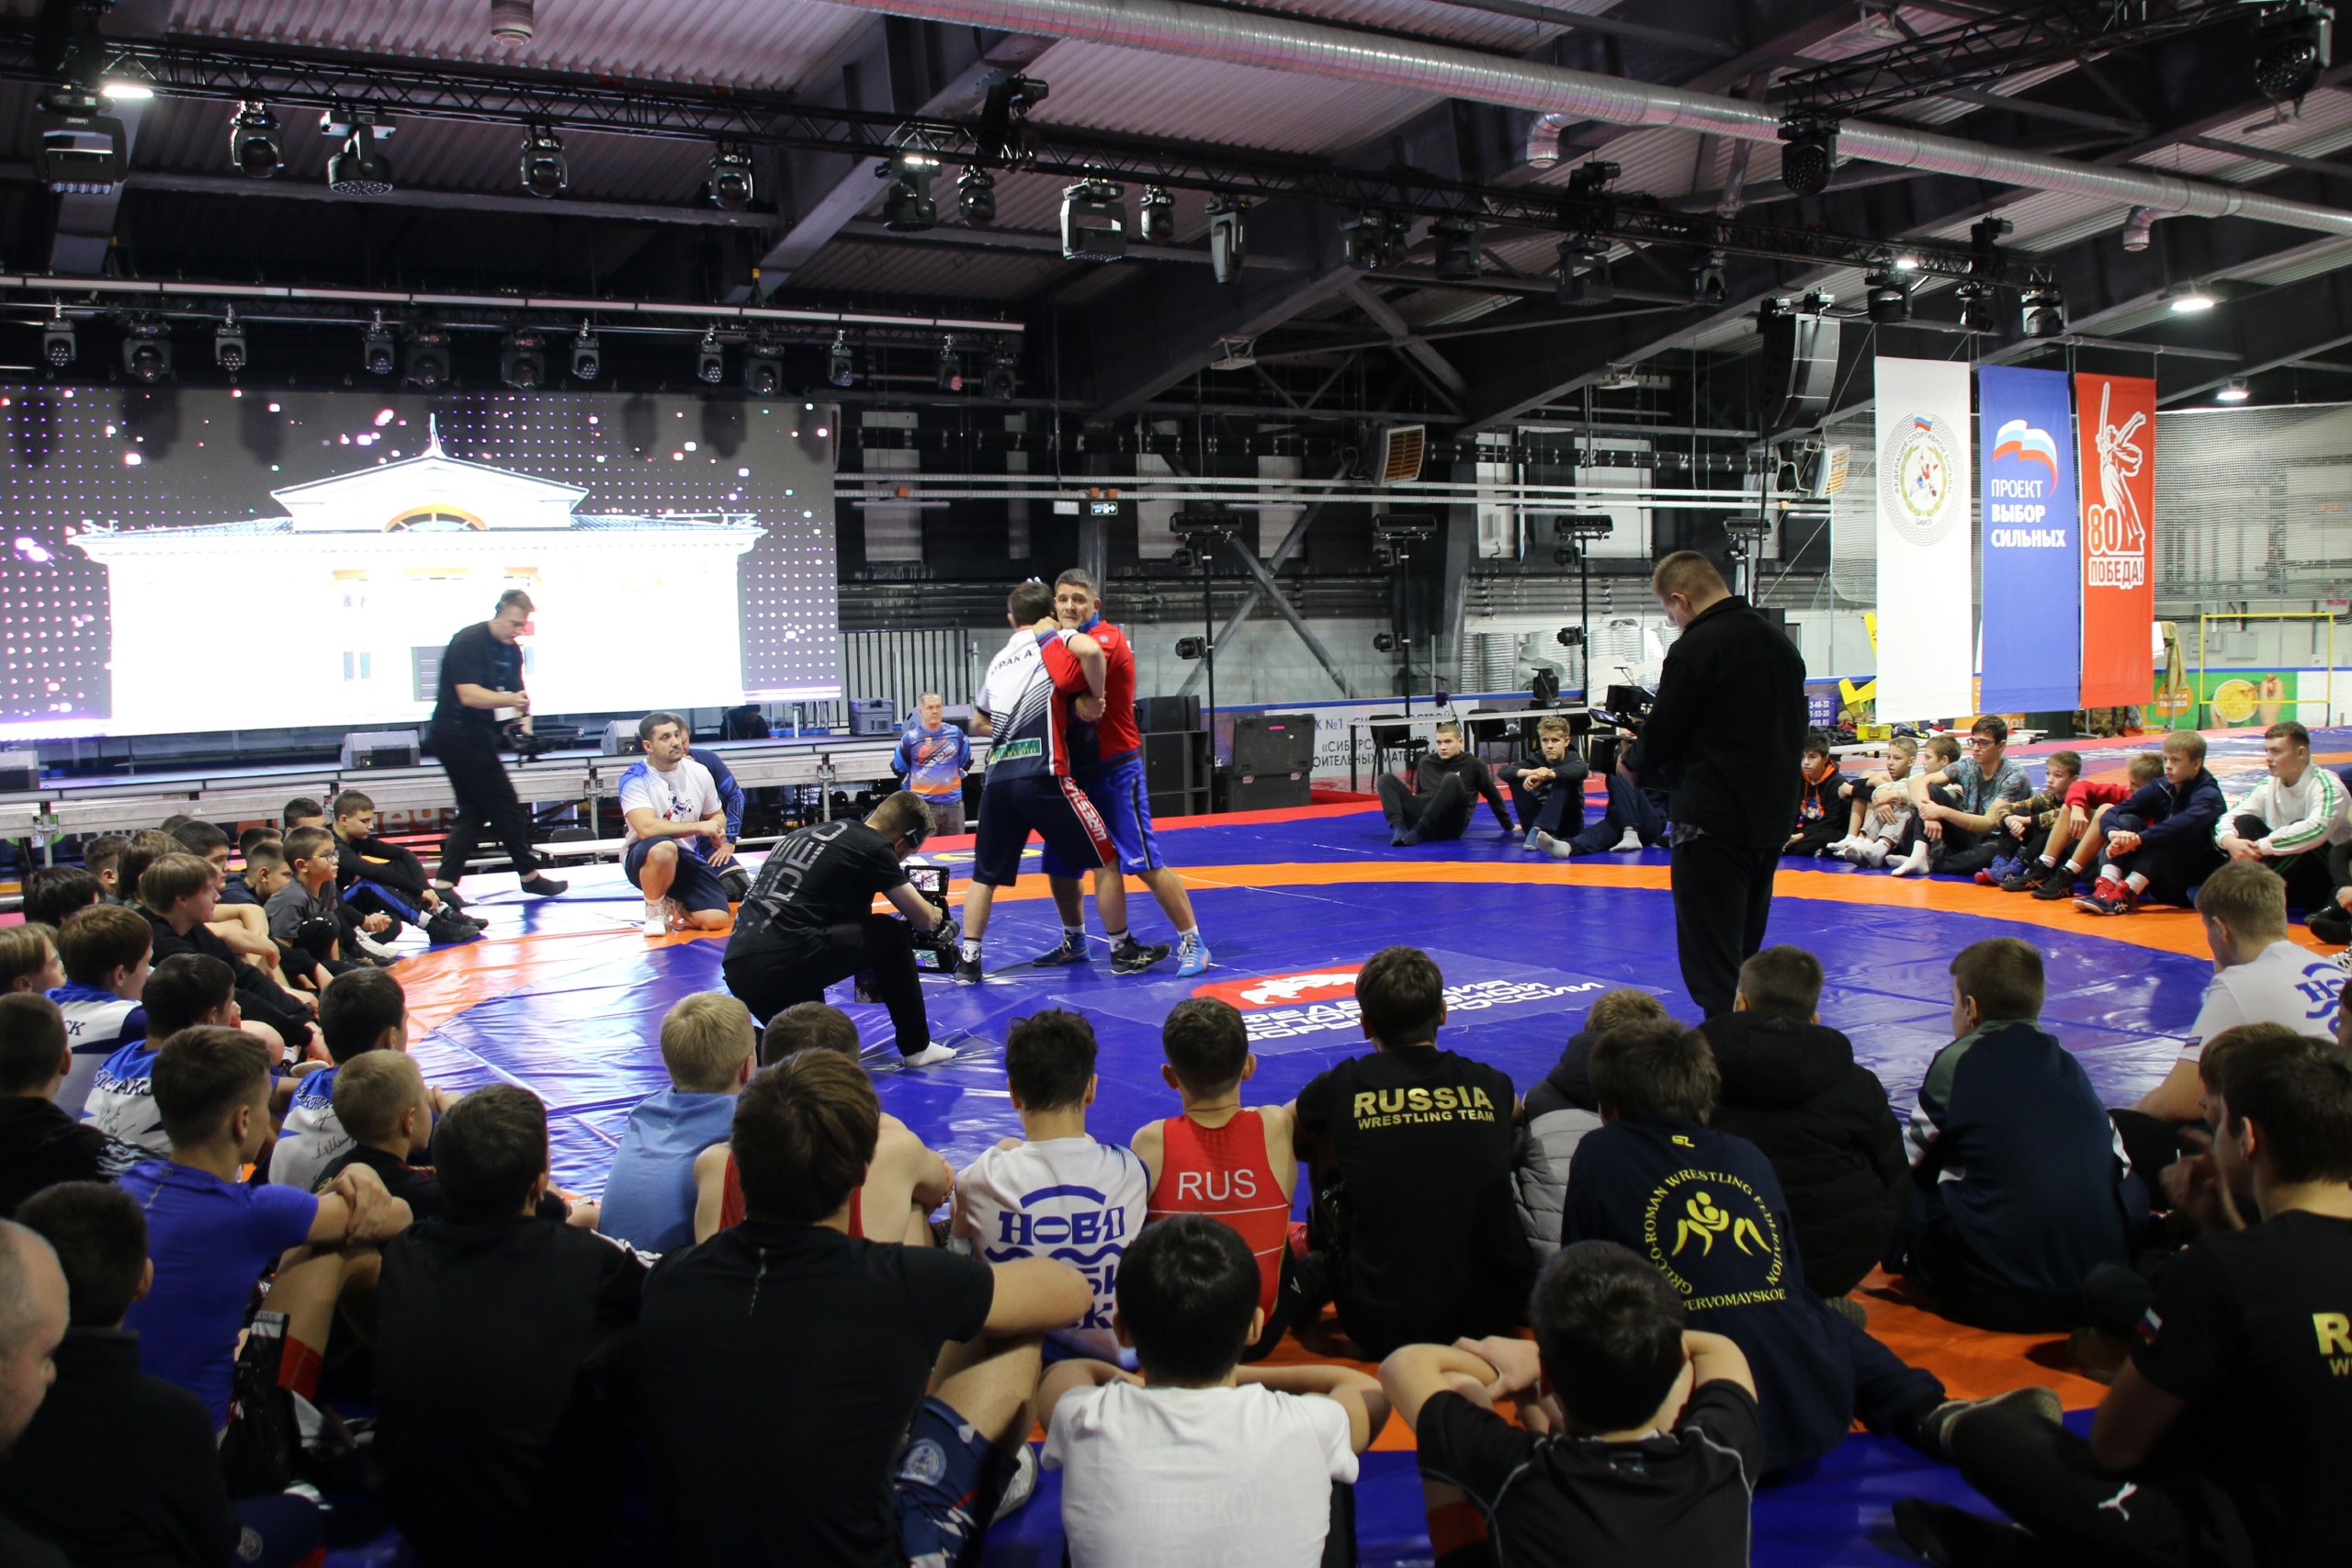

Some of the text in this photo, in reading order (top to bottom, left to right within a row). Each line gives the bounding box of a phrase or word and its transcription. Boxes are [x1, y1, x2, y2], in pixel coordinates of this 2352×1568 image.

[1991, 479, 2043, 499] ПРОЕКТ
[1991, 503, 2046, 524] ВЫБОР
[1990, 528, 2067, 548] СИЛЬНЫХ
[2088, 504, 2122, 556] 80
[2089, 558, 2144, 589] ПОБЕДА!
[1354, 1085, 1494, 1119] RUSSIA
[1358, 1108, 1495, 1131] WRESTLING TEAM
[1177, 1168, 1258, 1201] RUS
[1644, 1168, 1783, 1295] GRECO-ROMAN WRESTLING FEDERATION
[2312, 1312, 2352, 1355] R
